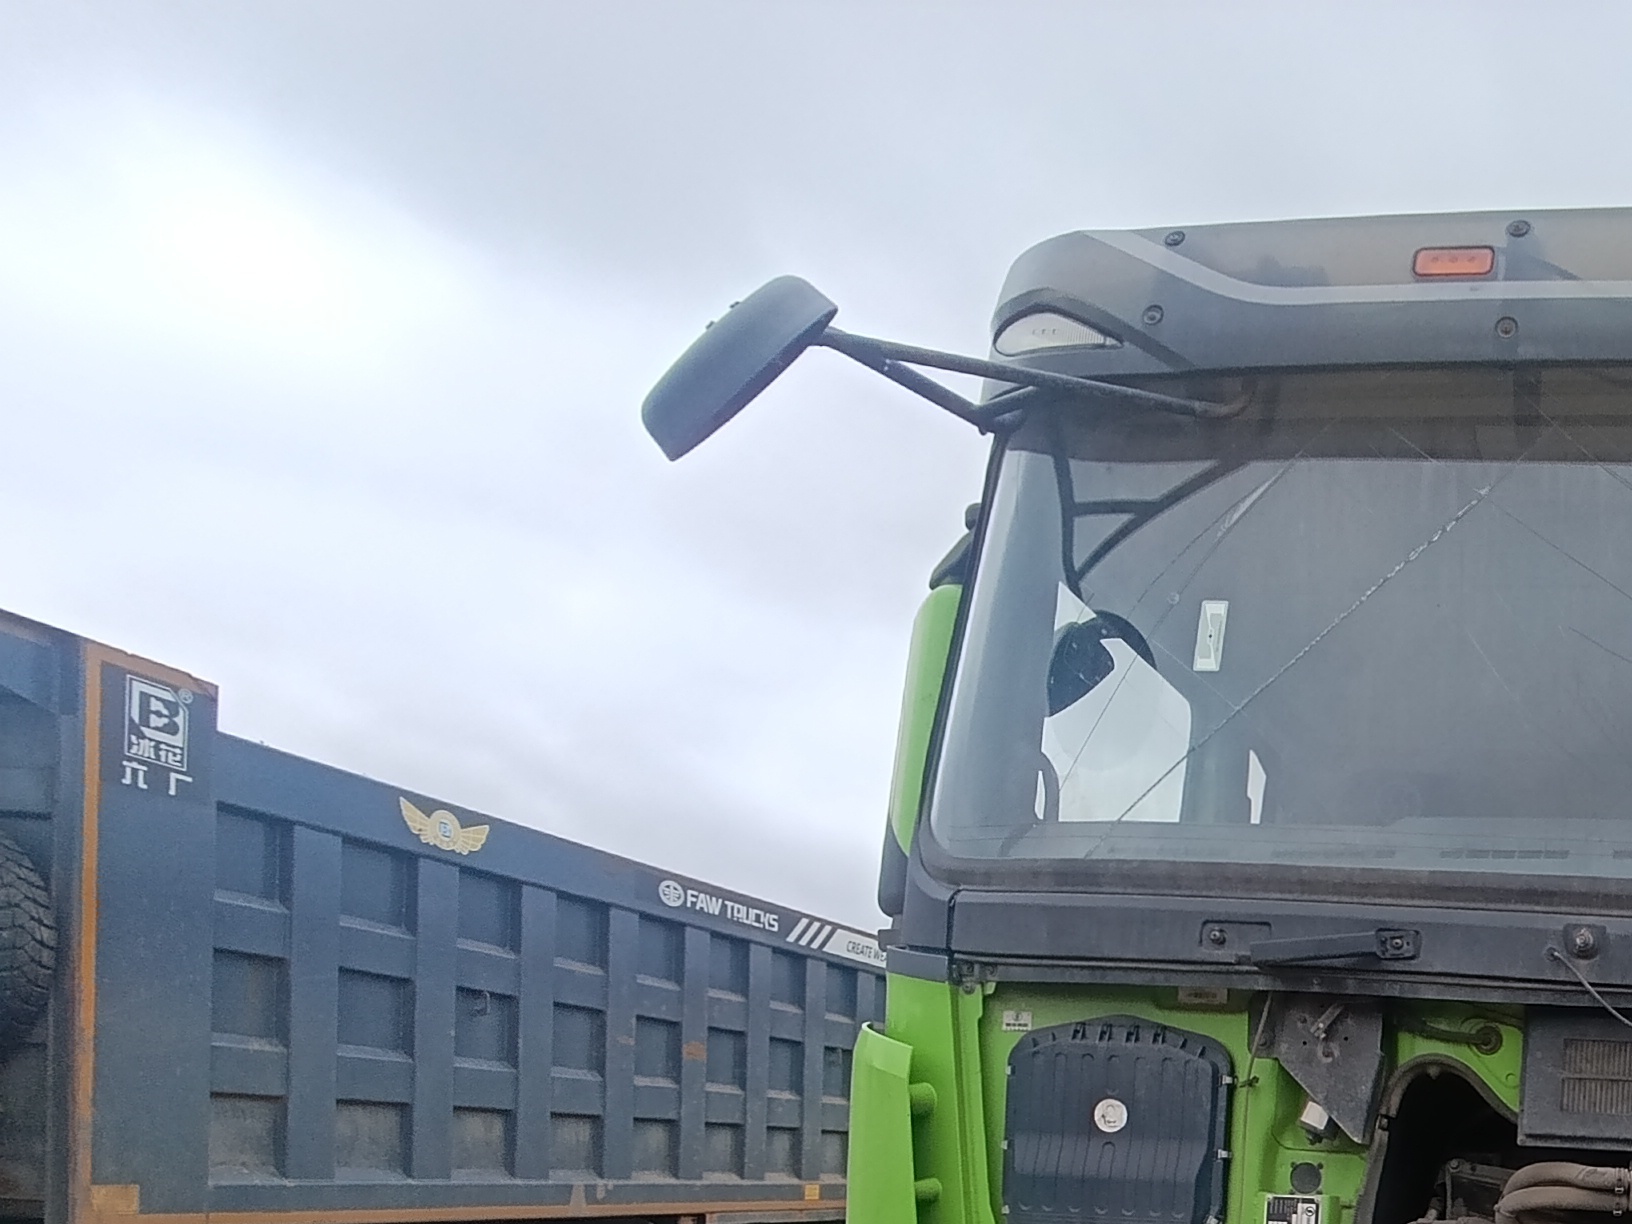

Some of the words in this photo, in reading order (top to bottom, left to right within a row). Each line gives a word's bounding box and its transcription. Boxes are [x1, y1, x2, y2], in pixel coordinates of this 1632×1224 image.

[686, 889, 723, 916] FAW
[724, 900, 779, 932] TRUCKS
[846, 940, 873, 959] CREATE
